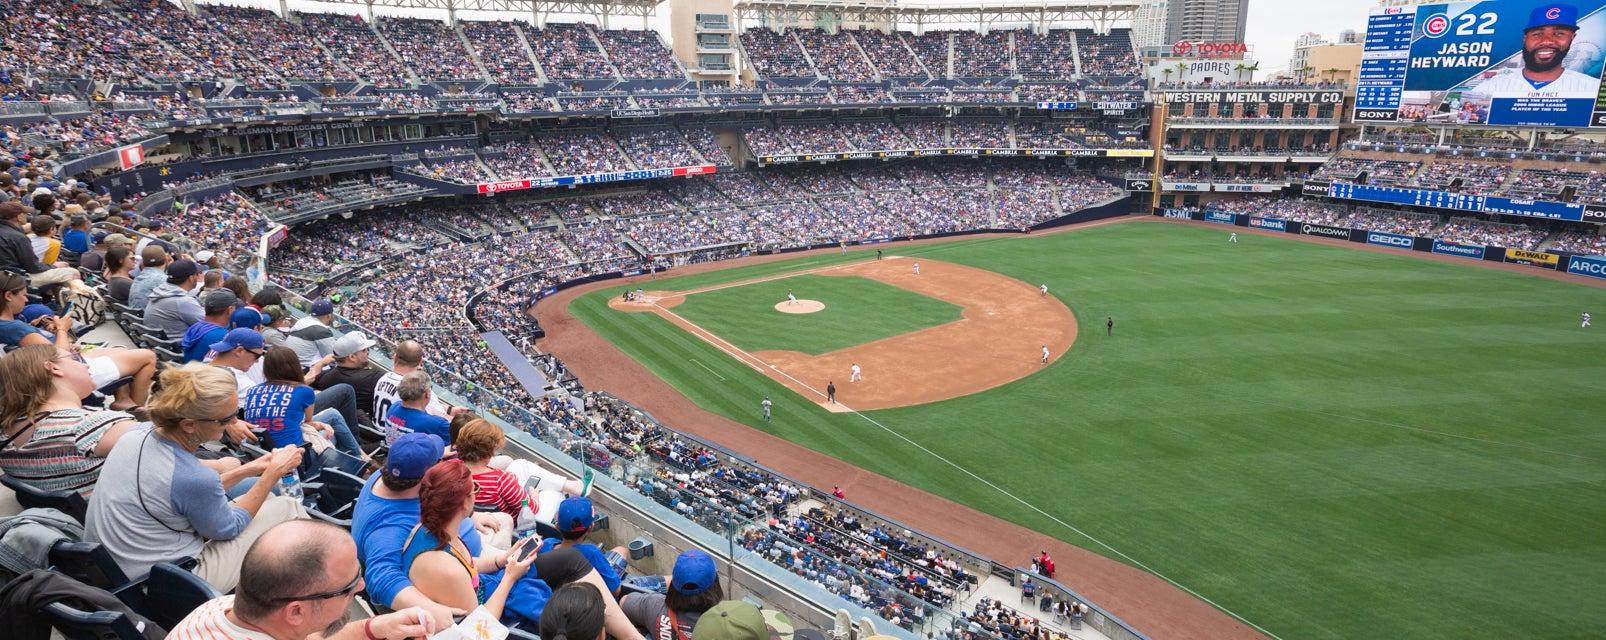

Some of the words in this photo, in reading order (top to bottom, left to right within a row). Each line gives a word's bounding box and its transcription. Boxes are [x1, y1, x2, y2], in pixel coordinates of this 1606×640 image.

[1456, 12, 1498, 35] 22
[1197, 44, 1247, 53] TOYOTA
[1437, 42, 1493, 55] JASON
[1411, 56, 1490, 68] HEYWARD
[1191, 62, 1230, 75] PADRES
[1166, 92, 1220, 102] WESTERN
[1226, 92, 1265, 102] METAL
[1269, 92, 1317, 102] SUPPLY
[1321, 92, 1342, 102] CO.
[1359, 111, 1394, 119] SONY
[276, 124, 328, 132] BROADCAST
[498, 182, 524, 190] TOYOTA
[1165, 210, 1191, 220] ASML
[1303, 225, 1348, 237] QUALCOMM
[1370, 234, 1411, 246] GEICO
[1436, 244, 1476, 255] Southwest
[378, 381, 397, 397] UPTON
[266, 406, 287, 417] THE
[373, 395, 392, 428] 10
